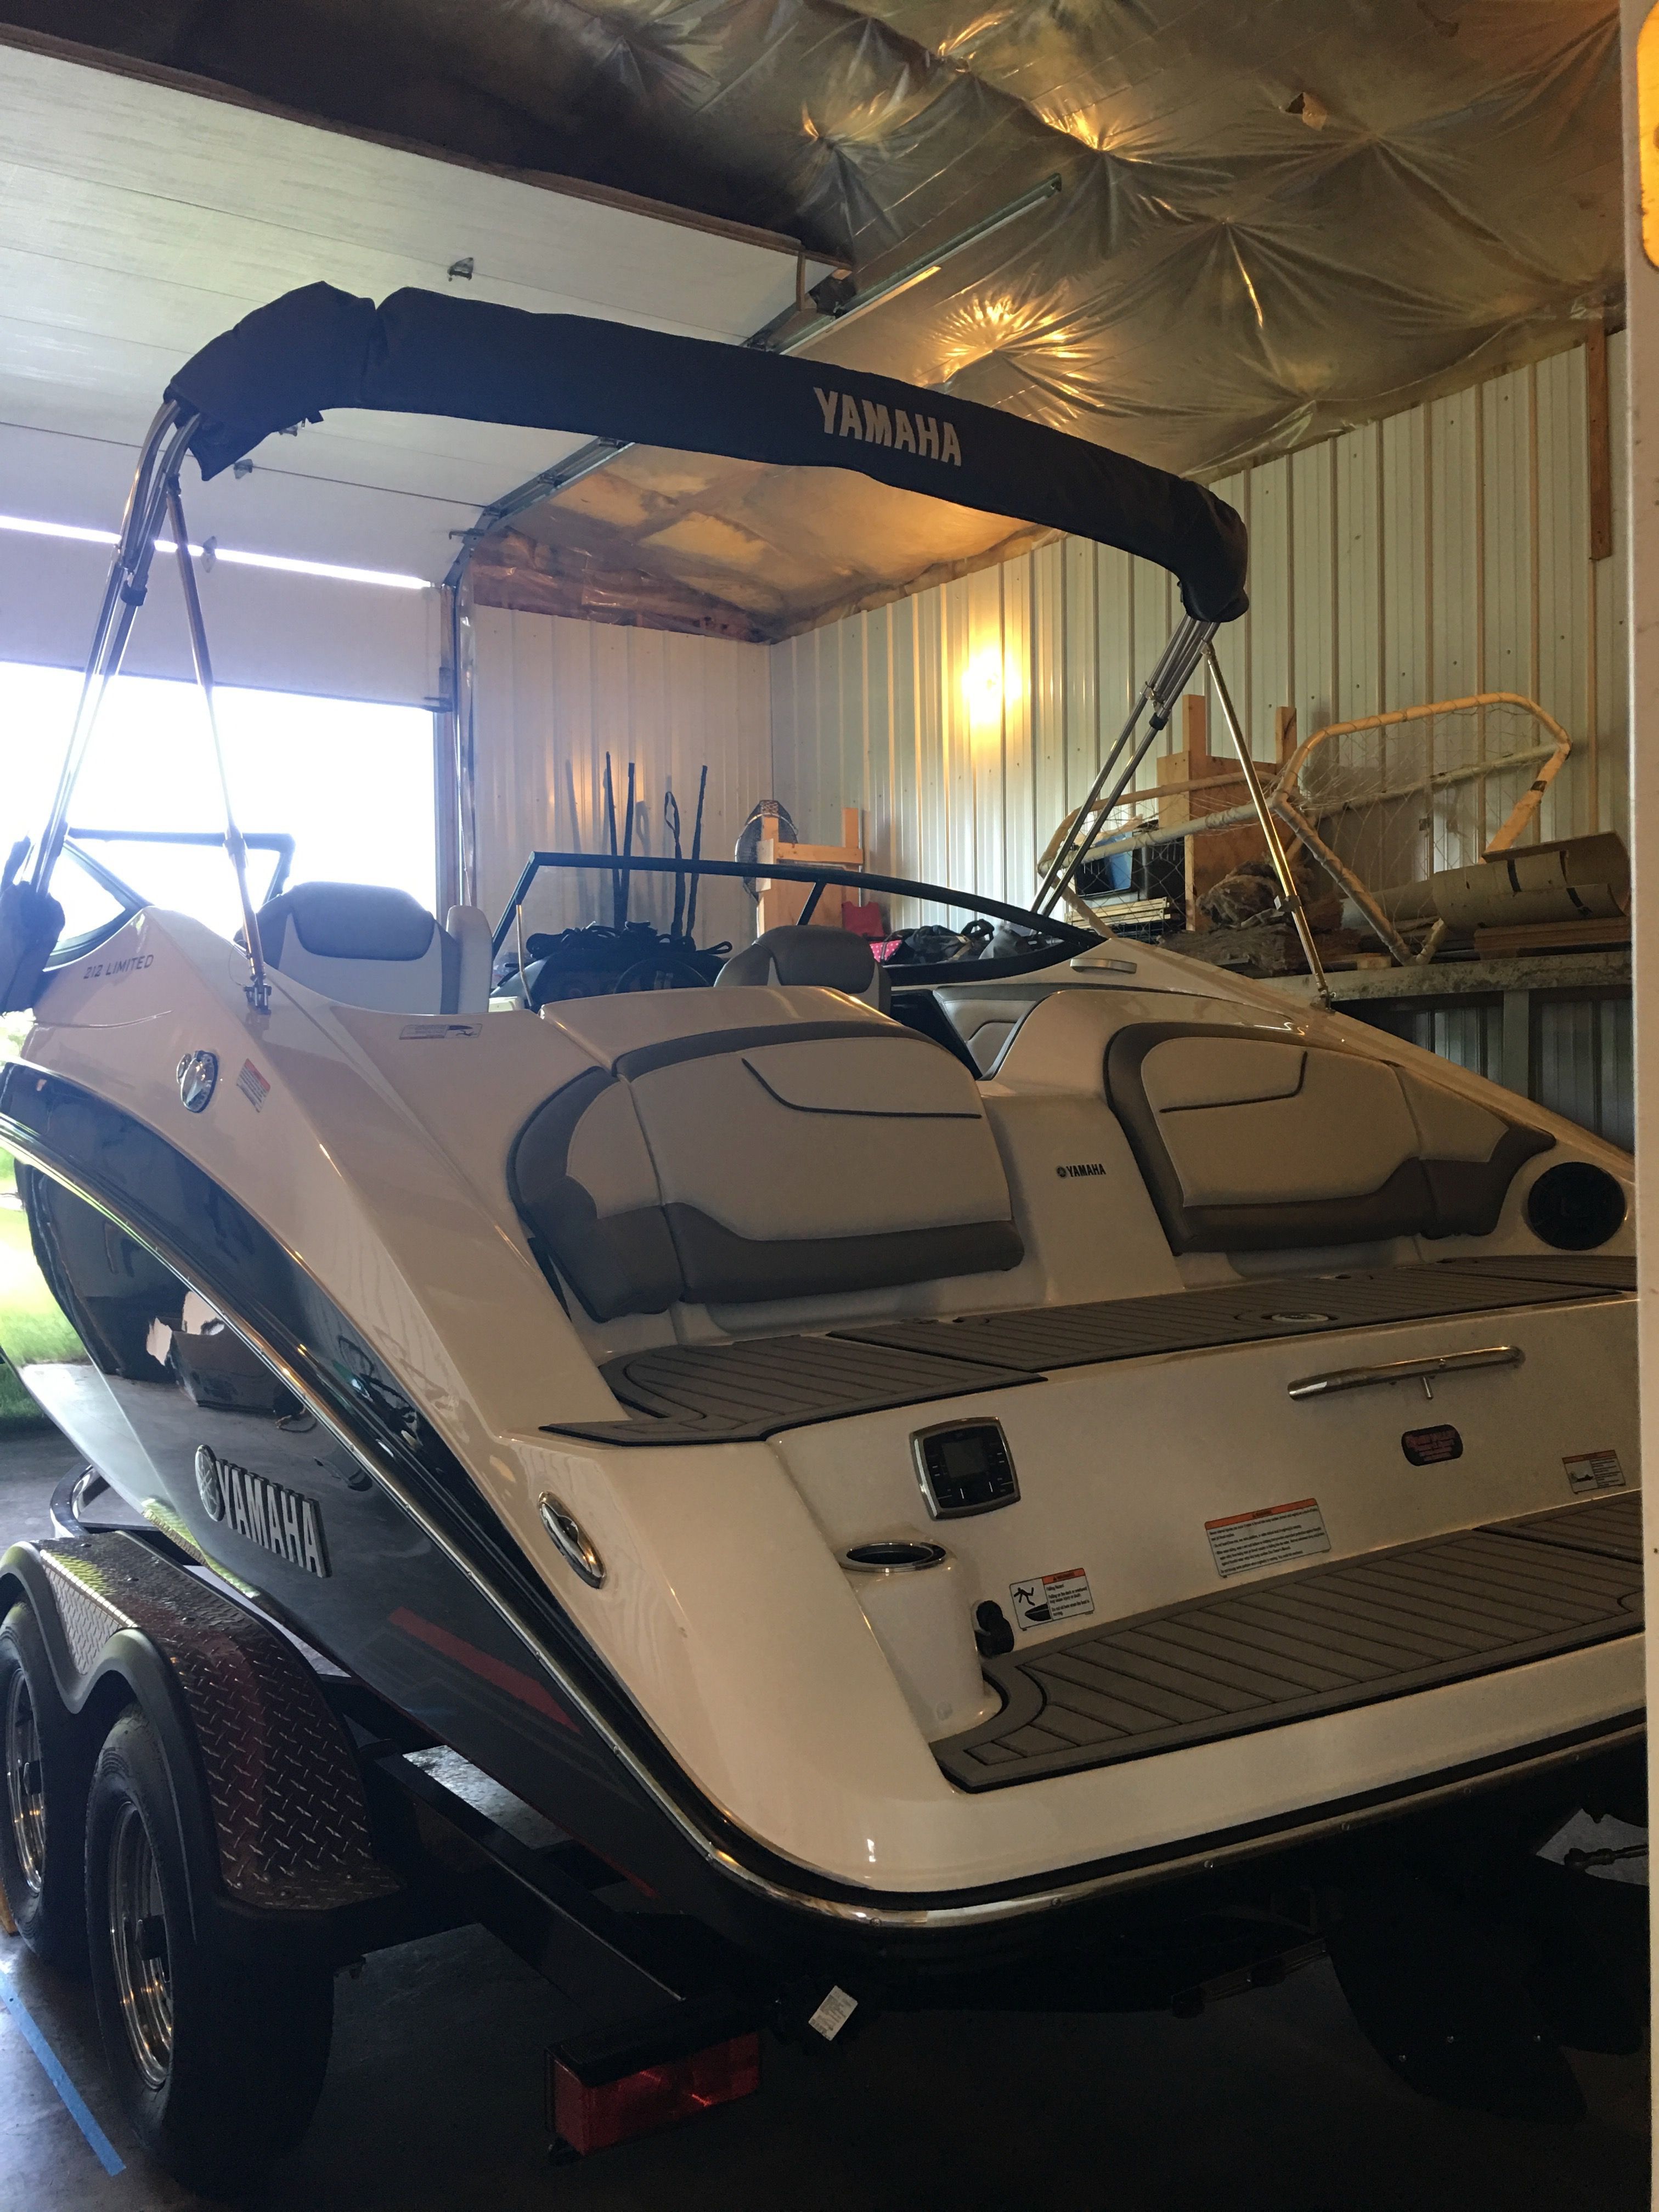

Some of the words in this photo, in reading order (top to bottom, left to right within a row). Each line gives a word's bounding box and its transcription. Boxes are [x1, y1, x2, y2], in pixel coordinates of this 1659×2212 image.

[813, 386, 962, 466] YAMAHA
[83, 964, 104, 979] 212
[105, 954, 154, 975] LIMITED
[1065, 1163, 1107, 1177] YAMAHA
[216, 1459, 330, 1578] YAMAHA
